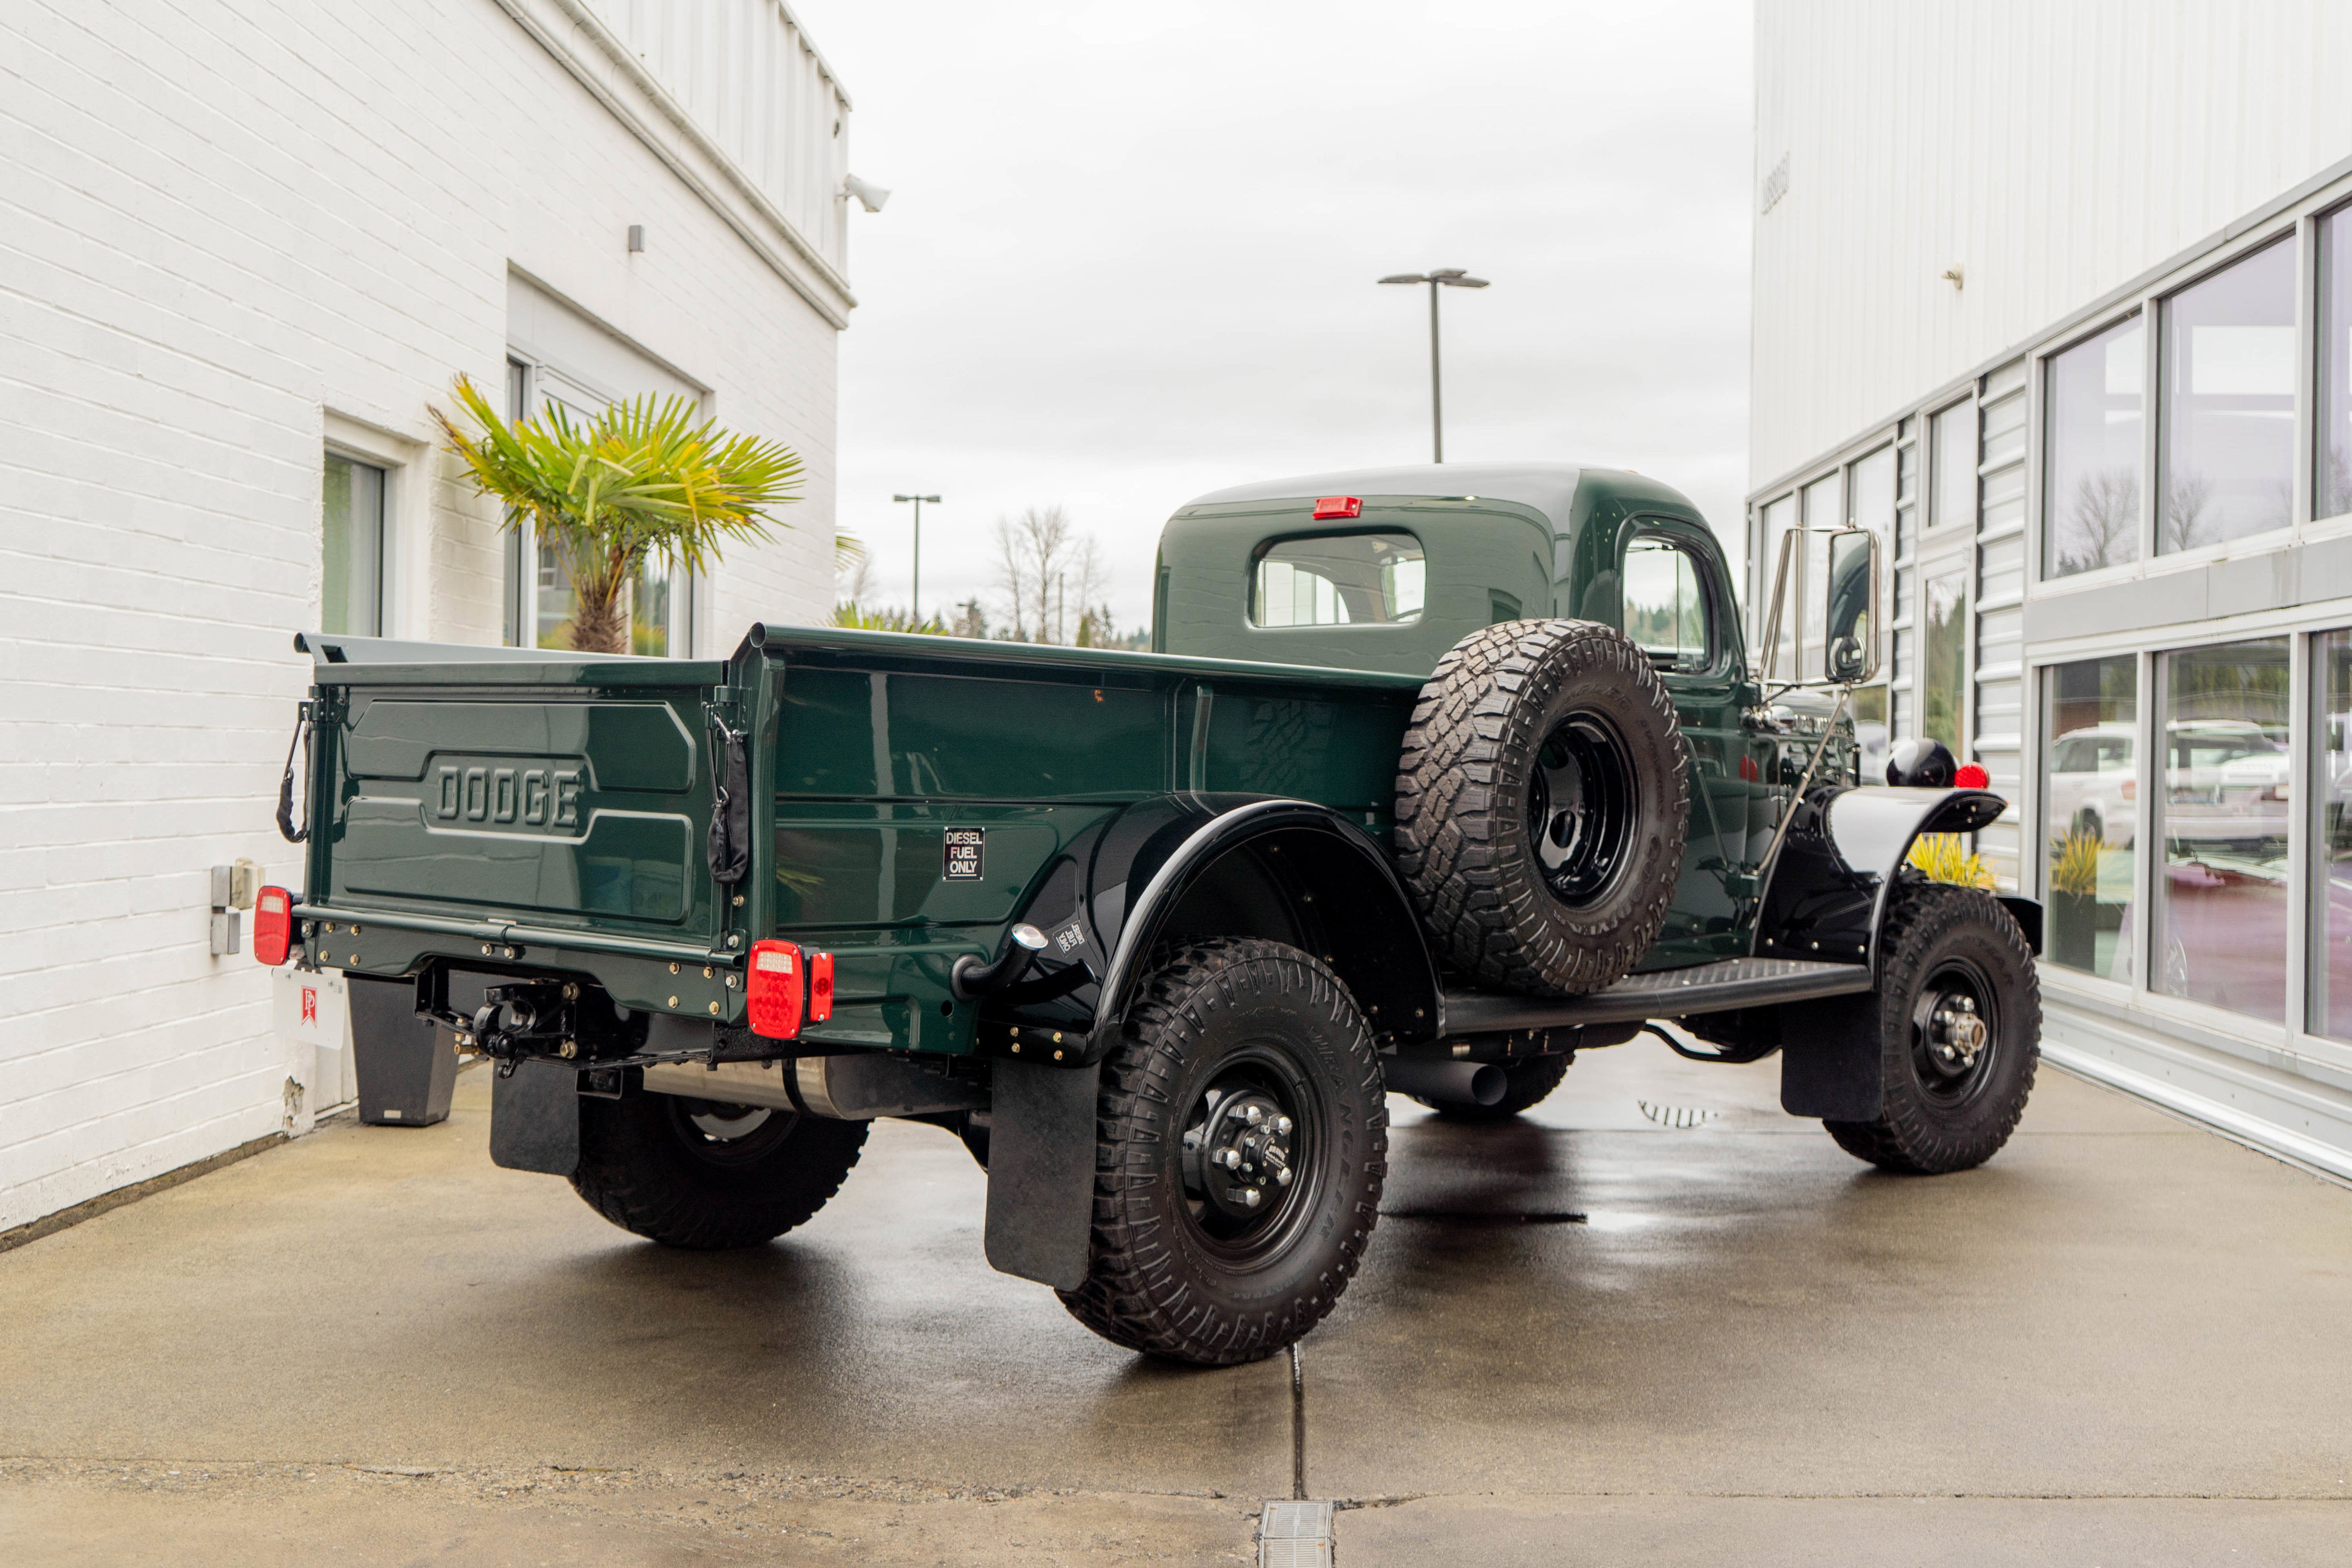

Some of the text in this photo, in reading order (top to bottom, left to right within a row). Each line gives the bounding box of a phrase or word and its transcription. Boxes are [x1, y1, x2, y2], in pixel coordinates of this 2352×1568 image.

[437, 766, 580, 826] DODGE
[946, 832, 983, 845] DIESEL
[950, 846, 978, 859] FUEL
[949, 860, 978, 873] ONLY
